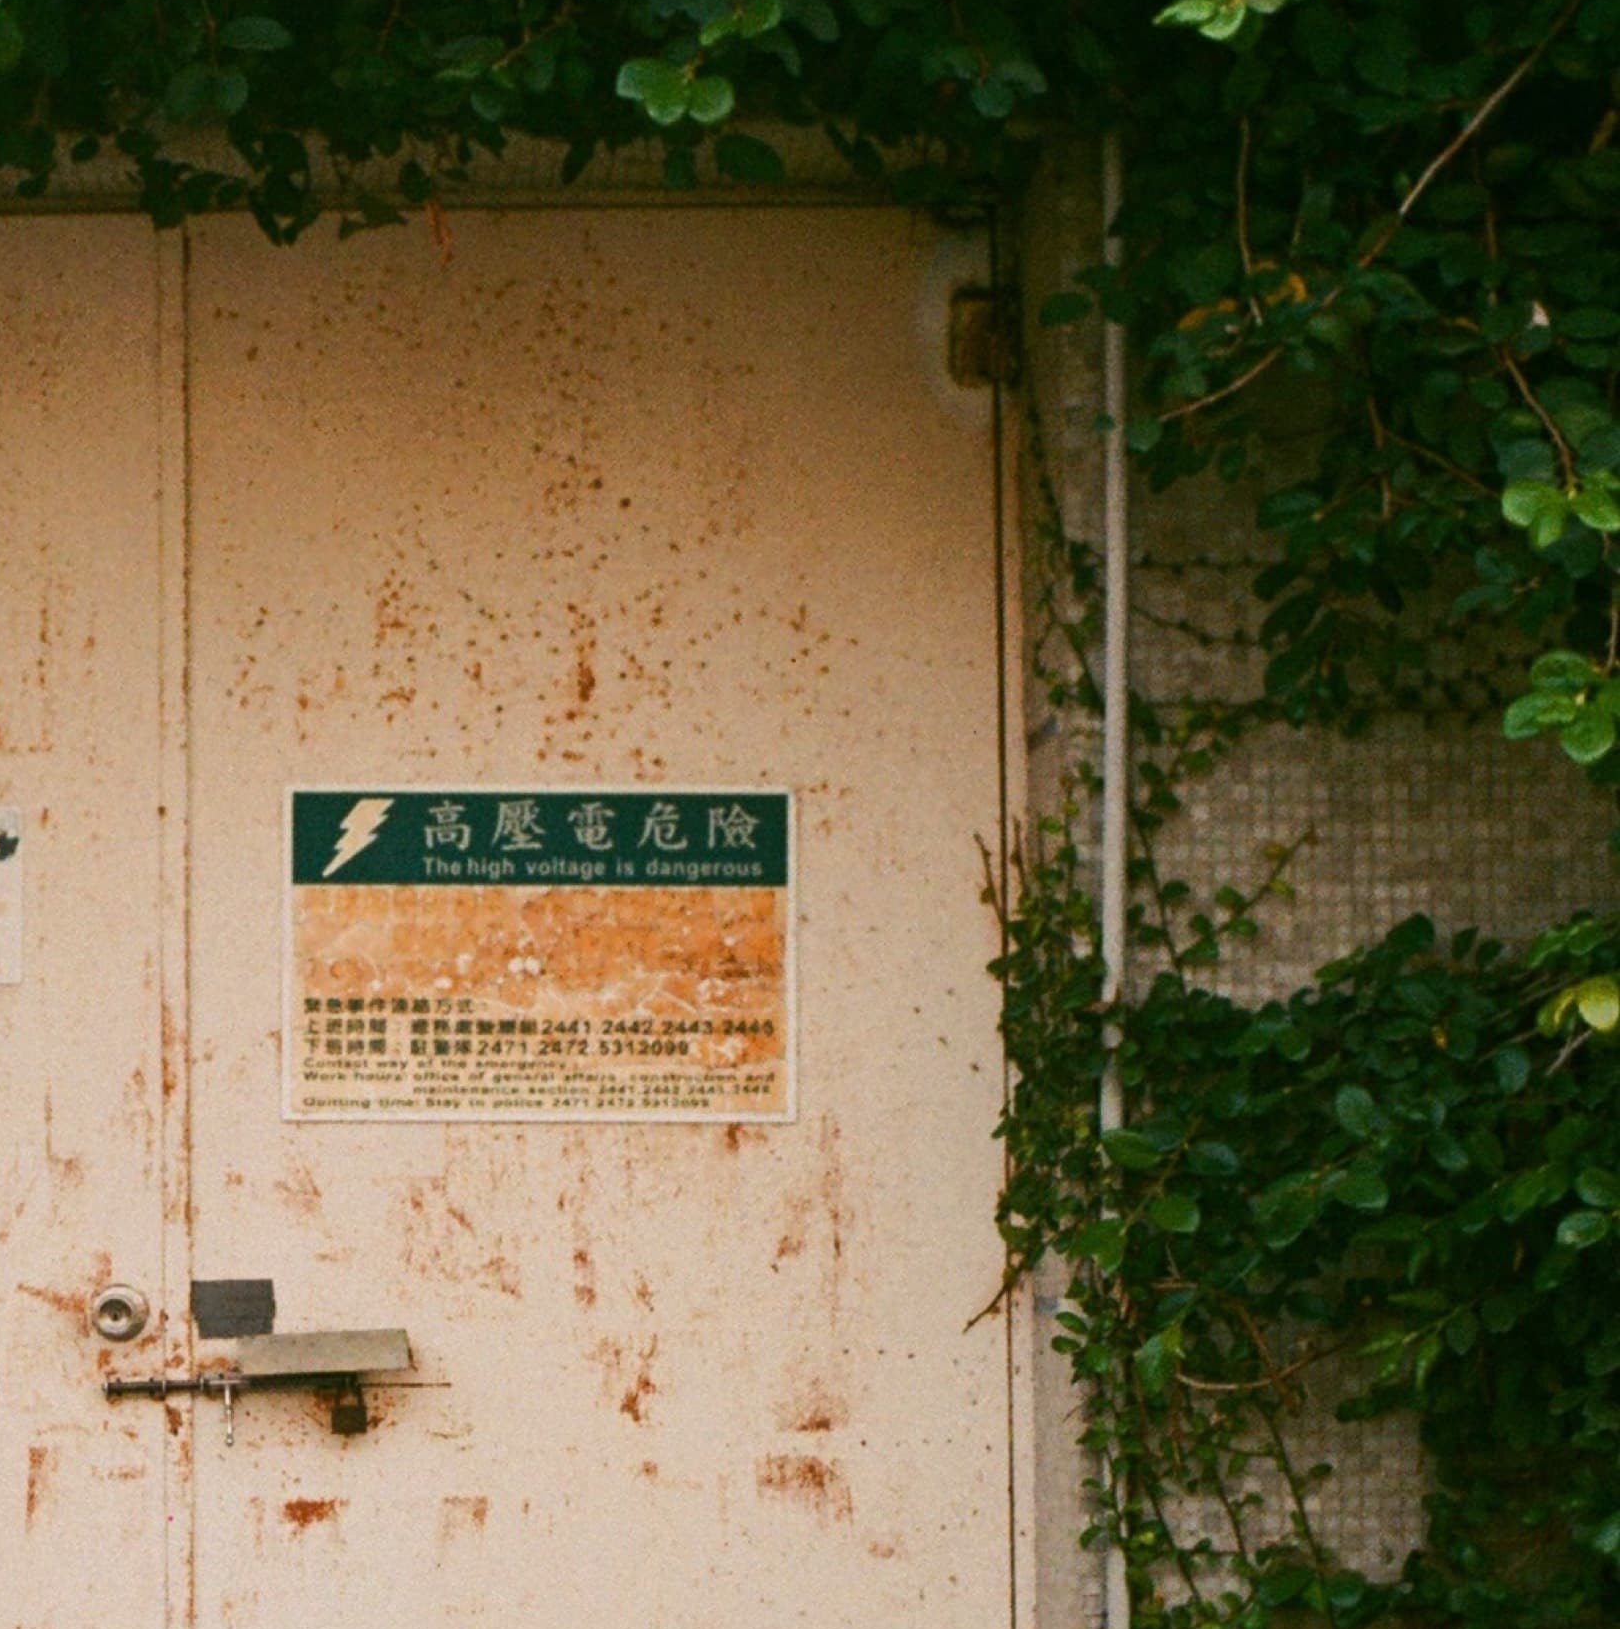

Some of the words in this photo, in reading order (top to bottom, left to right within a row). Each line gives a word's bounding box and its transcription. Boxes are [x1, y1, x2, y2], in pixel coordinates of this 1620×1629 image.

[424, 799, 760, 850] 高壓電危險
[423, 857, 461, 876] The
[467, 857, 515, 880] high
[525, 858, 606, 880] voltage
[616, 858, 635, 876] is
[645, 859, 763, 880] dangerous
